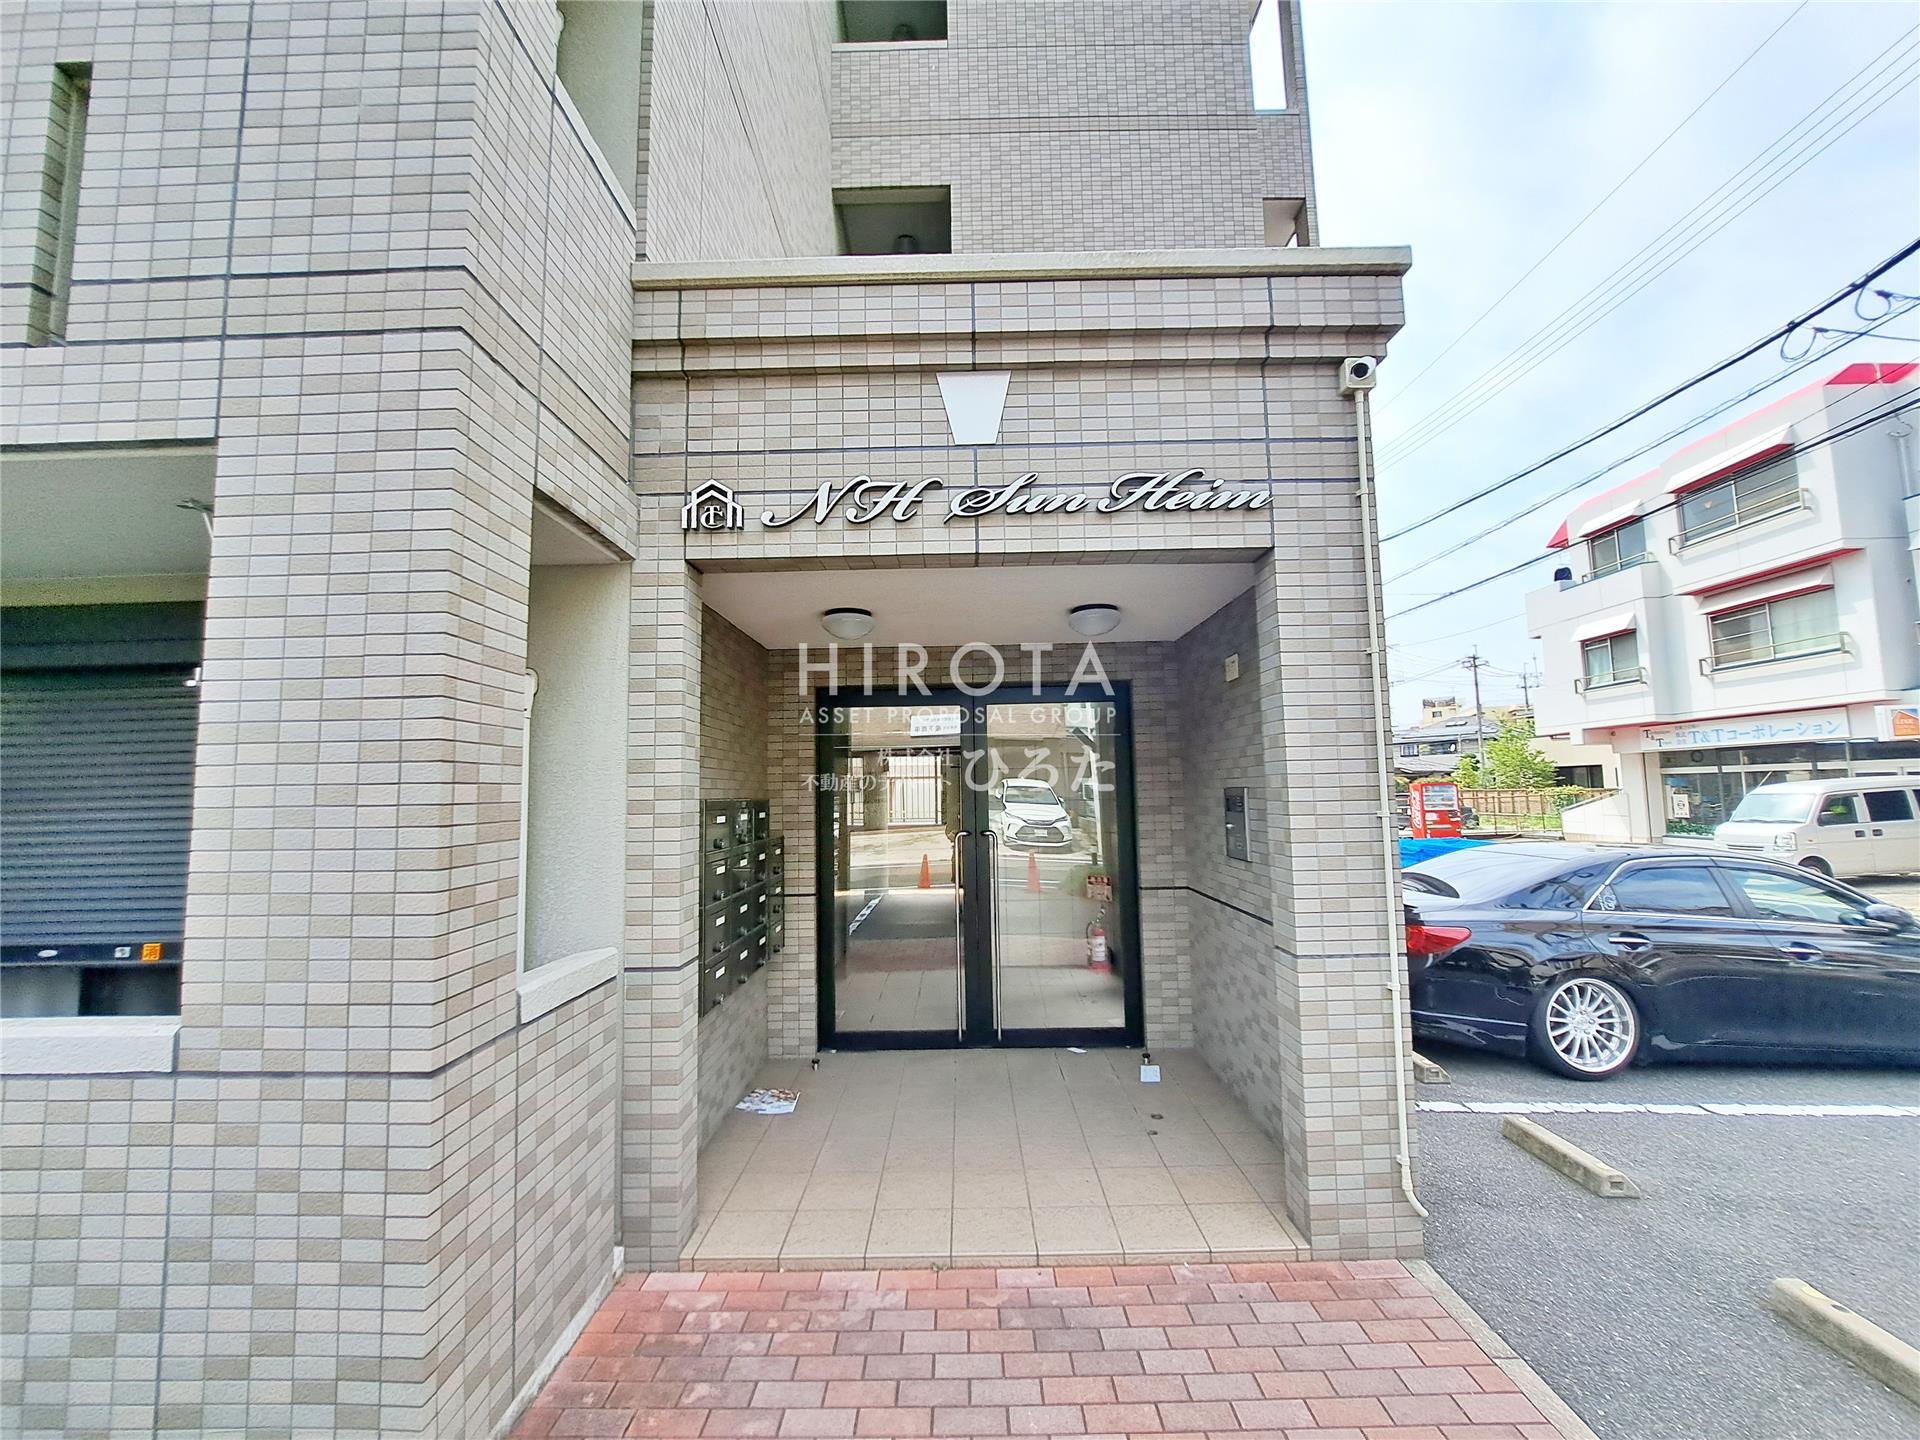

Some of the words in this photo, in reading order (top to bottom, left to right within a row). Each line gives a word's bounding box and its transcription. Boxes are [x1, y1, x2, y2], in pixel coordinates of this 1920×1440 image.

[761, 475, 943, 526] NH
[944, 472, 1093, 524] Sun
[1097, 468, 1275, 513] Heim
